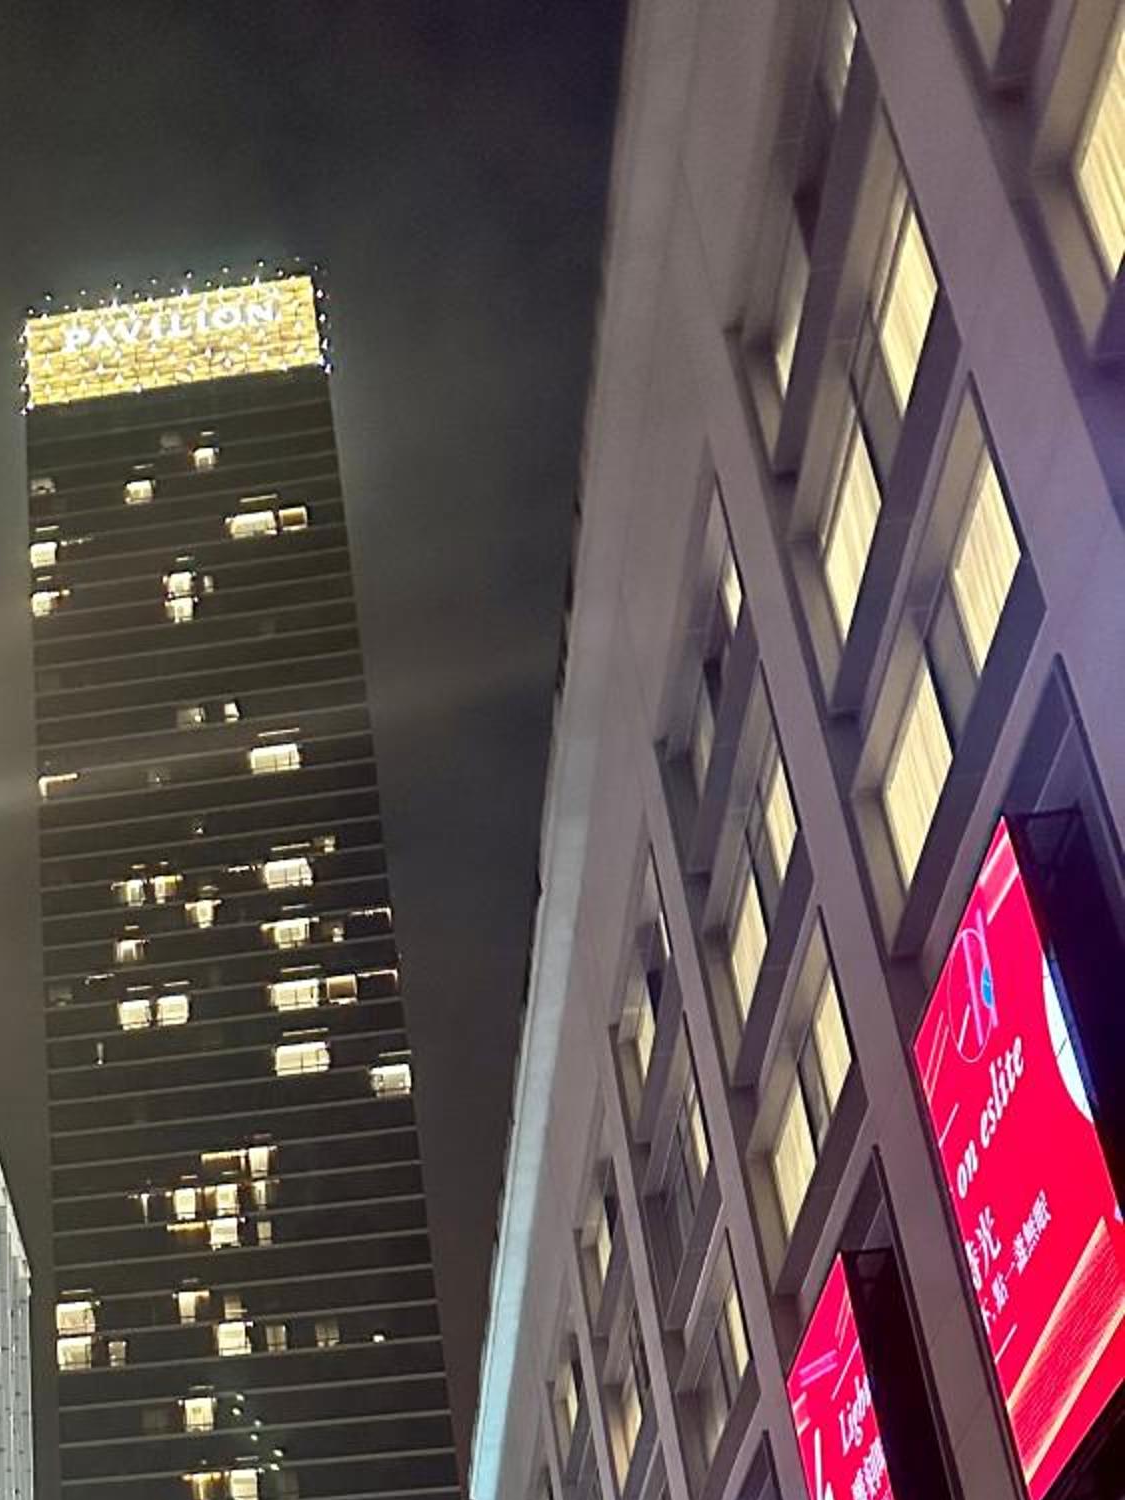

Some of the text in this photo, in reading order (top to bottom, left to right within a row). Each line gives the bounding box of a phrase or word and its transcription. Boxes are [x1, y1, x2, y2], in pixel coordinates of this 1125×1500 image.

[63, 303, 276, 351] PAVILION
[957, 1036, 1024, 1199] on eslite
